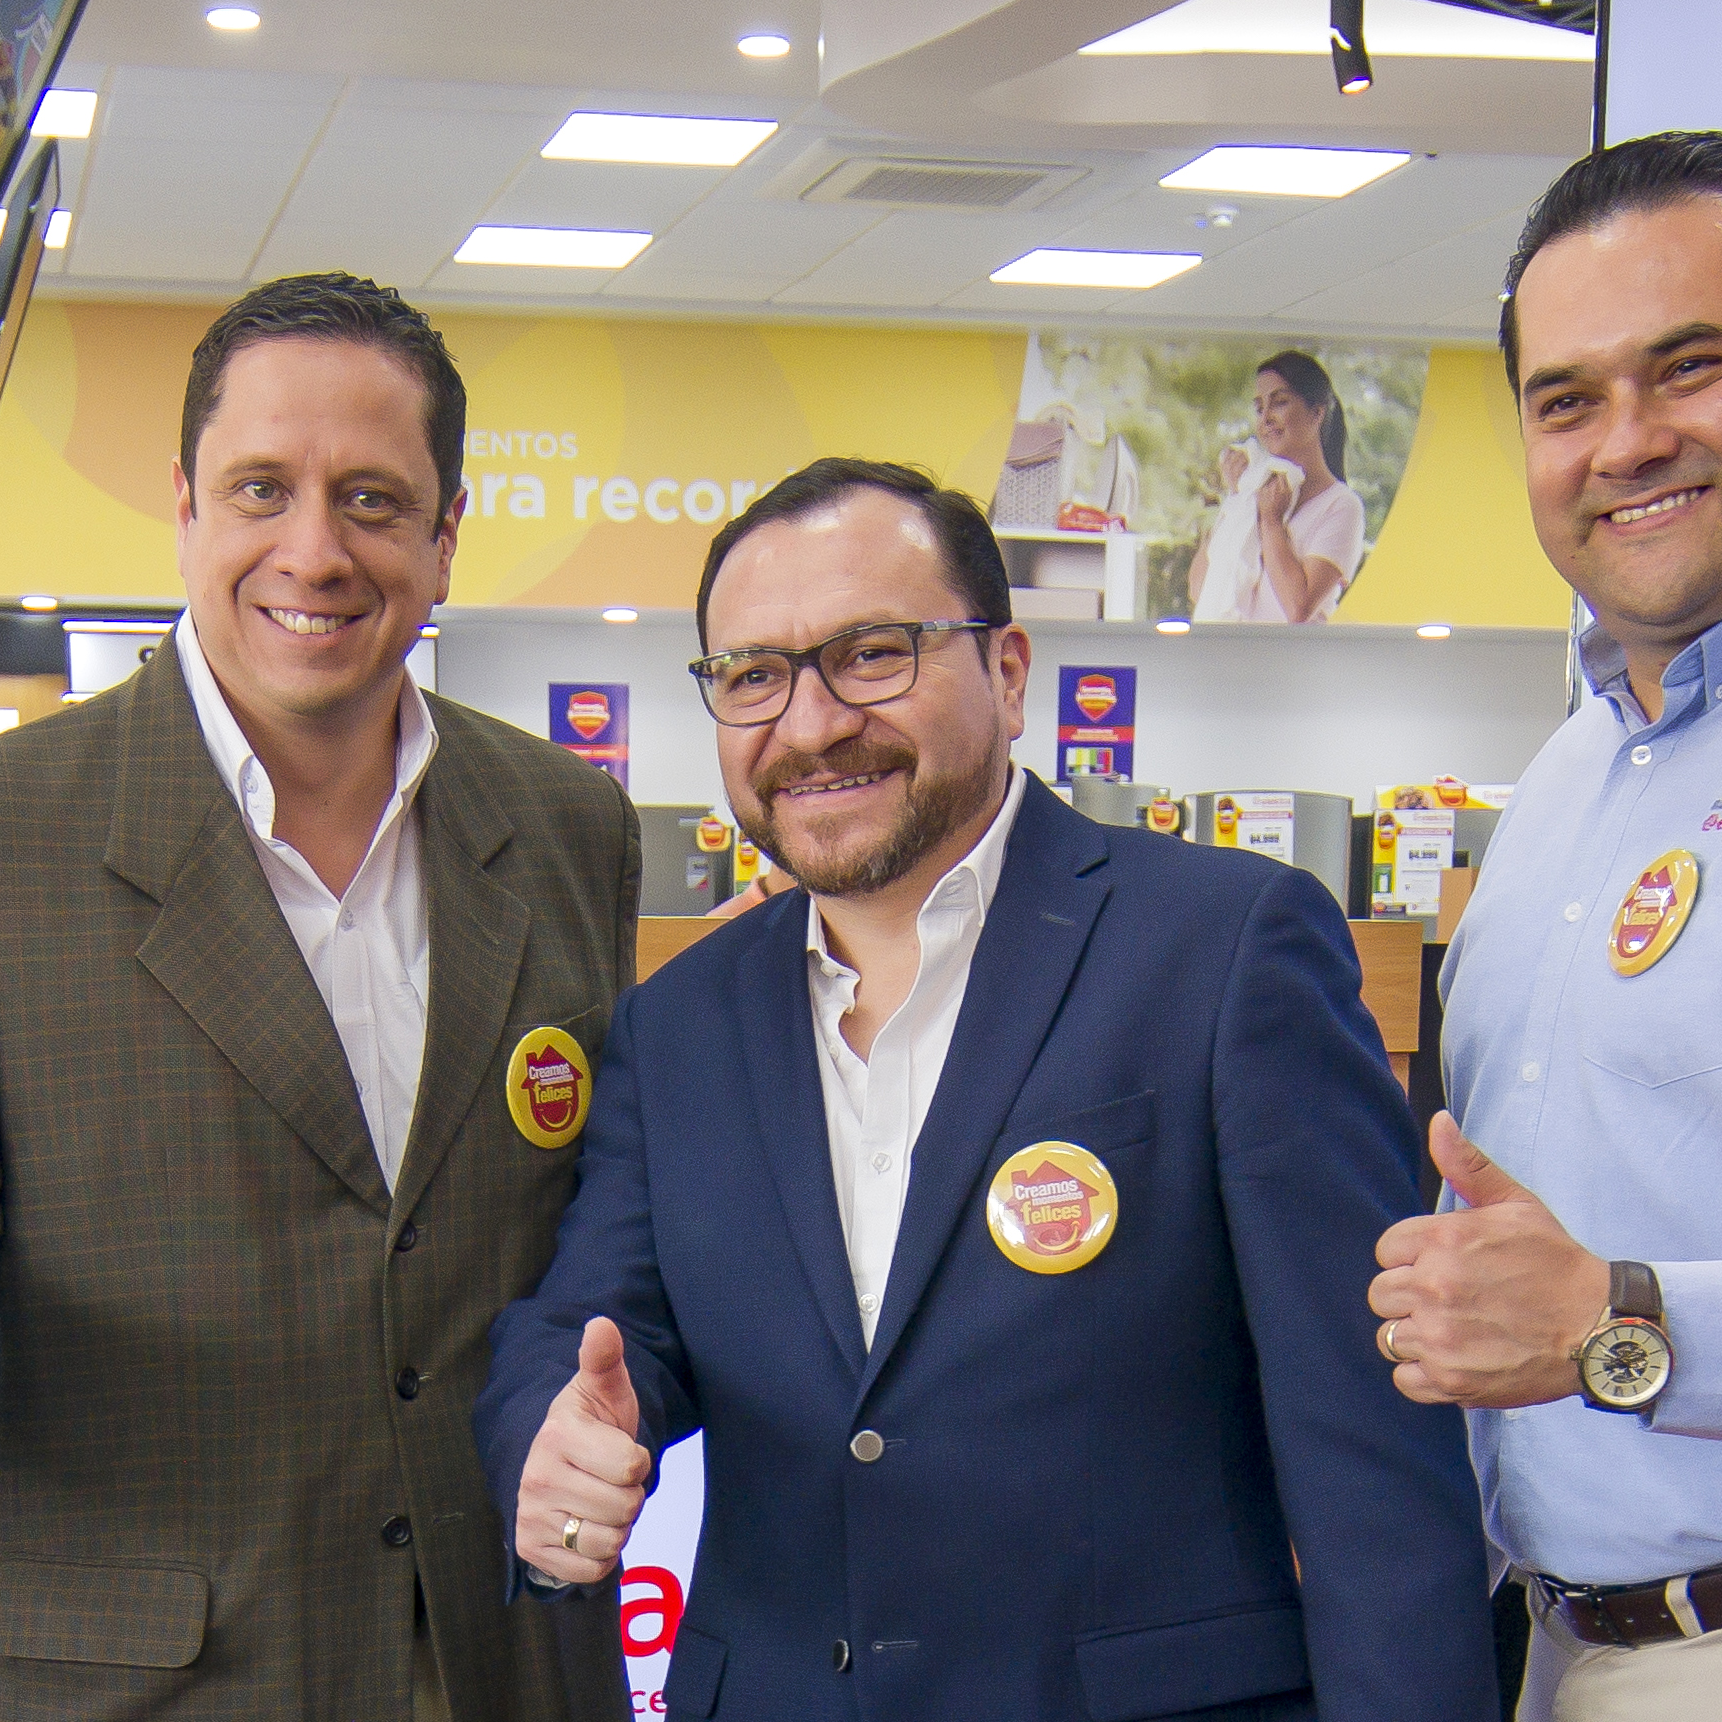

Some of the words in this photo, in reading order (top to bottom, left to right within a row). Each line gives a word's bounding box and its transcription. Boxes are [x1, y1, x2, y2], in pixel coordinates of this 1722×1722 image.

[469, 429, 578, 459] ENTOS
[573, 467, 796, 524] recor
[1014, 1178, 1079, 1201] Creamos
[1021, 1200, 1082, 1226] felices
